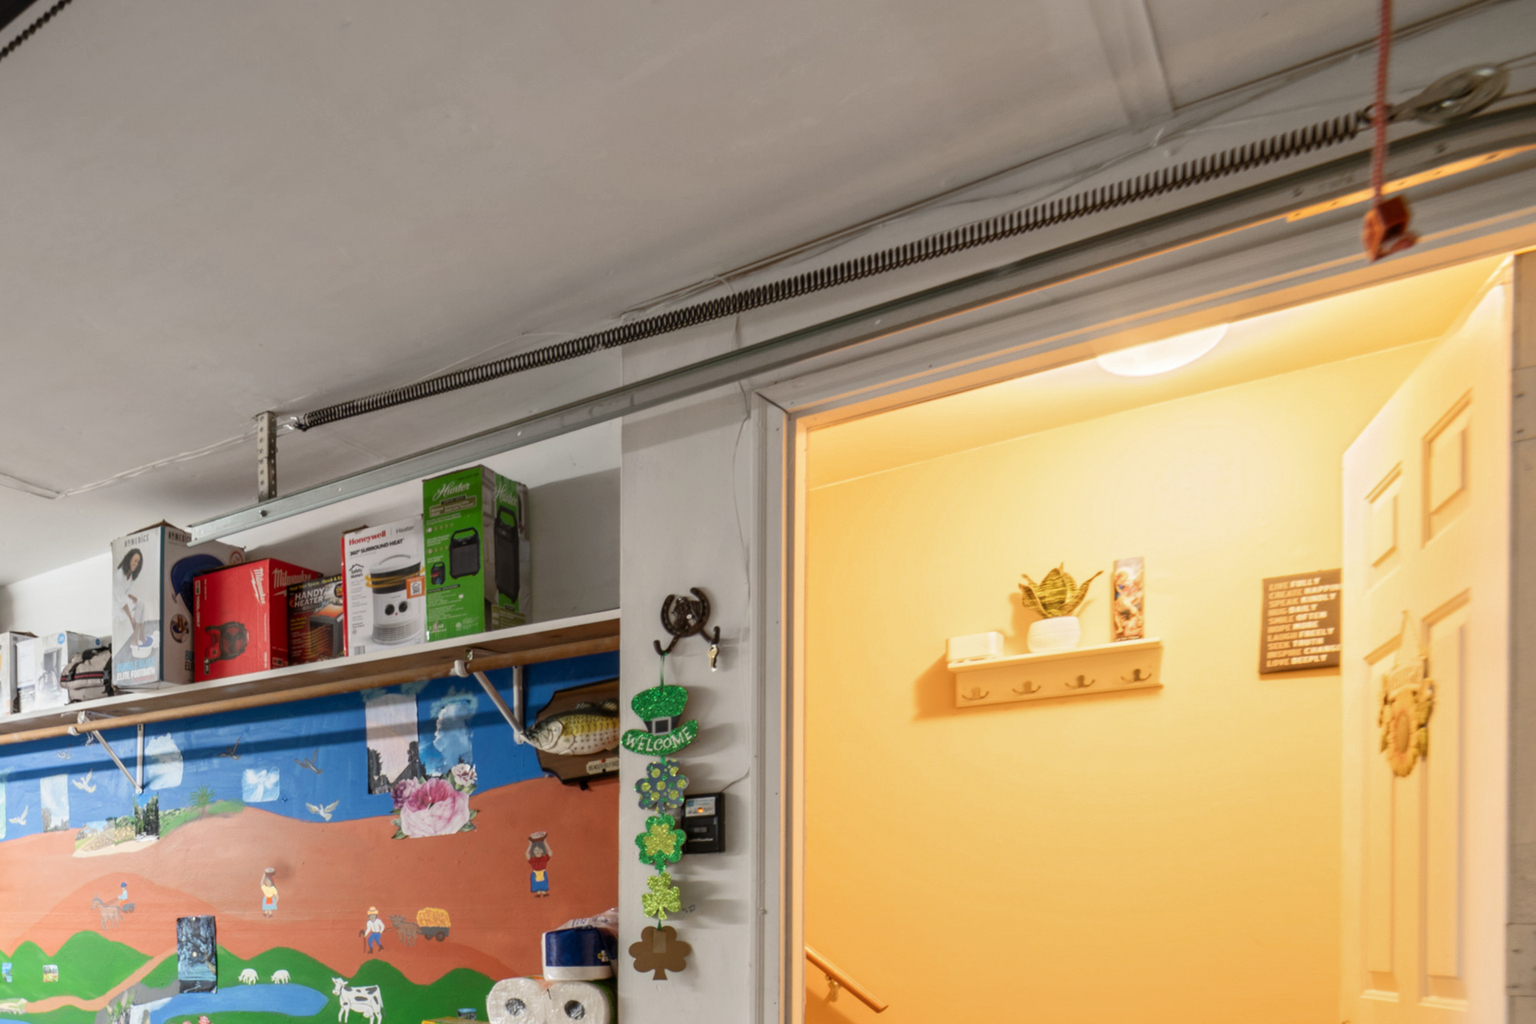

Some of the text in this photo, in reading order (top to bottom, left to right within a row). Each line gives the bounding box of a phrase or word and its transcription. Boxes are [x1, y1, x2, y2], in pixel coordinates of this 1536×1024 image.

[432, 481, 471, 501] Hunter
[492, 482, 518, 507] Hunter
[348, 525, 415, 546] Honeywell Heater
[360, 542, 390, 554] SURROUND
[253, 566, 266, 604] Milwaukee
[272, 567, 312, 589] Milwaukee
[1289, 577, 1321, 588] FULLY
[295, 587, 325, 601] HANDY
[294, 596, 324, 608] HEATER
[1295, 611, 1327, 622] OFTEN
[1298, 627, 1335, 638] FREELY
[1292, 637, 1324, 648] TRUTH
[117, 666, 155, 680] ELITE FOOTBATH
[626, 726, 692, 752] WELCOME
